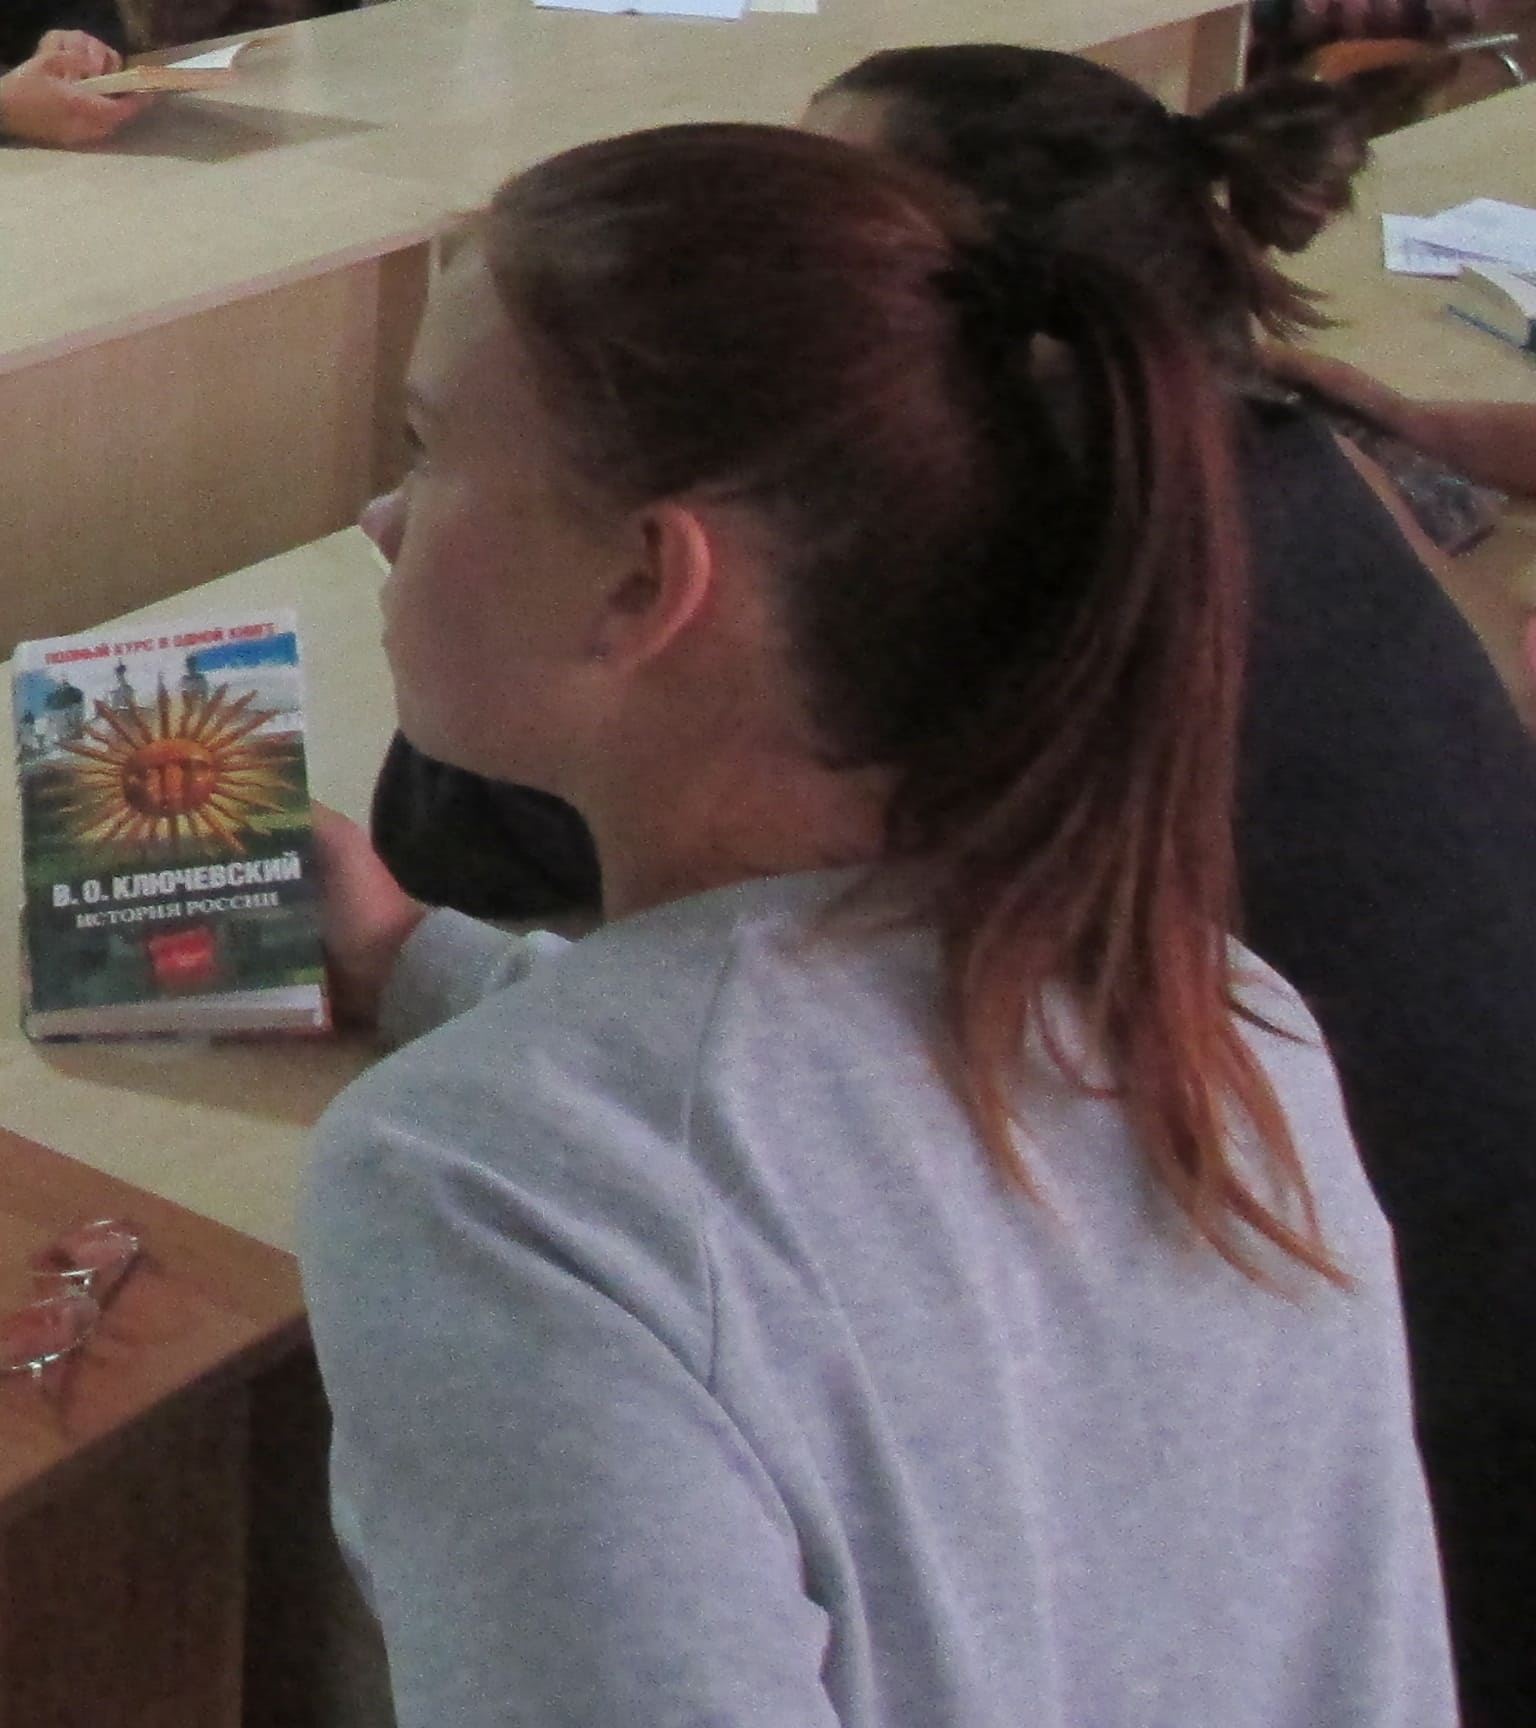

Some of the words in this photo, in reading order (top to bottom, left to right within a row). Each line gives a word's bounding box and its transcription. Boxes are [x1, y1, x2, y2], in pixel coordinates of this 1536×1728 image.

[114, 637, 154, 655] КУРС
[52, 883, 78, 907] В.
[82, 879, 109, 903] О.
[112, 850, 302, 900] КЛЮЧЕВСКИЙ
[75, 903, 182, 928] ИСТОРИЯ
[186, 891, 279, 917] РОССИИ
